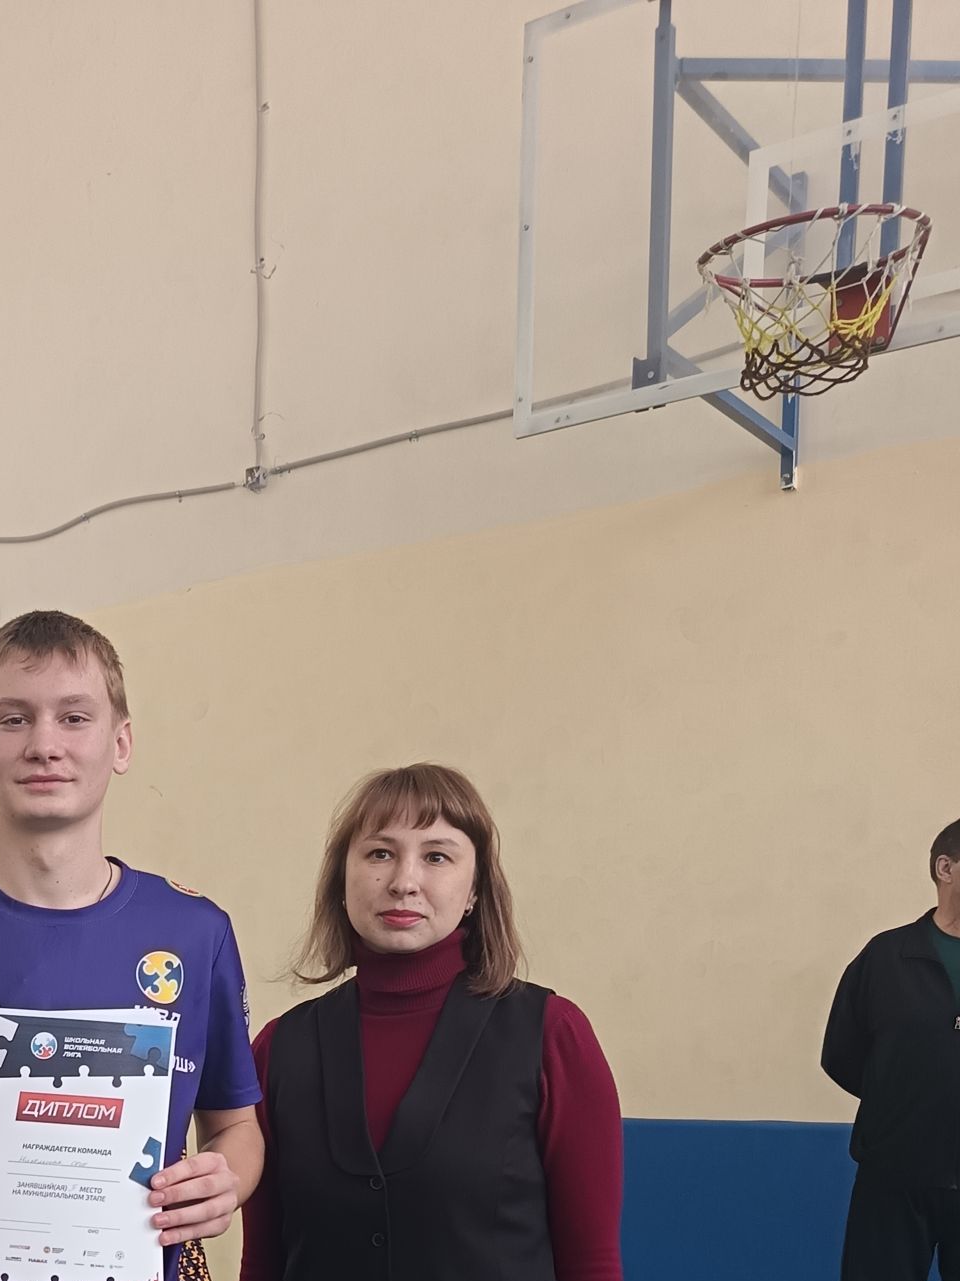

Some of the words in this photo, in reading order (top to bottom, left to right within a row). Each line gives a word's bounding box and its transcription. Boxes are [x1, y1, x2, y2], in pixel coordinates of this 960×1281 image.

[64, 1037, 106, 1045] ШКОЛЬНАЯ
[63, 1044, 123, 1054] ВОЛЕЙБОЛЬНАЯ
[22, 1100, 117, 1121] ДИПЛОМ
[22, 1143, 76, 1153] НАГРАЖДАЕТСЯ
[77, 1147, 112, 1156] КОМАНДА
[17, 1181, 68, 1192] ЗАНЯВШИЙ(АЯ)
[79, 1186, 103, 1194] МЕСТО
[22, 1190, 85, 1200] МУНИЦИПАЛЬНОМ
[85, 1195, 106, 1203] ЭТАПЕ
